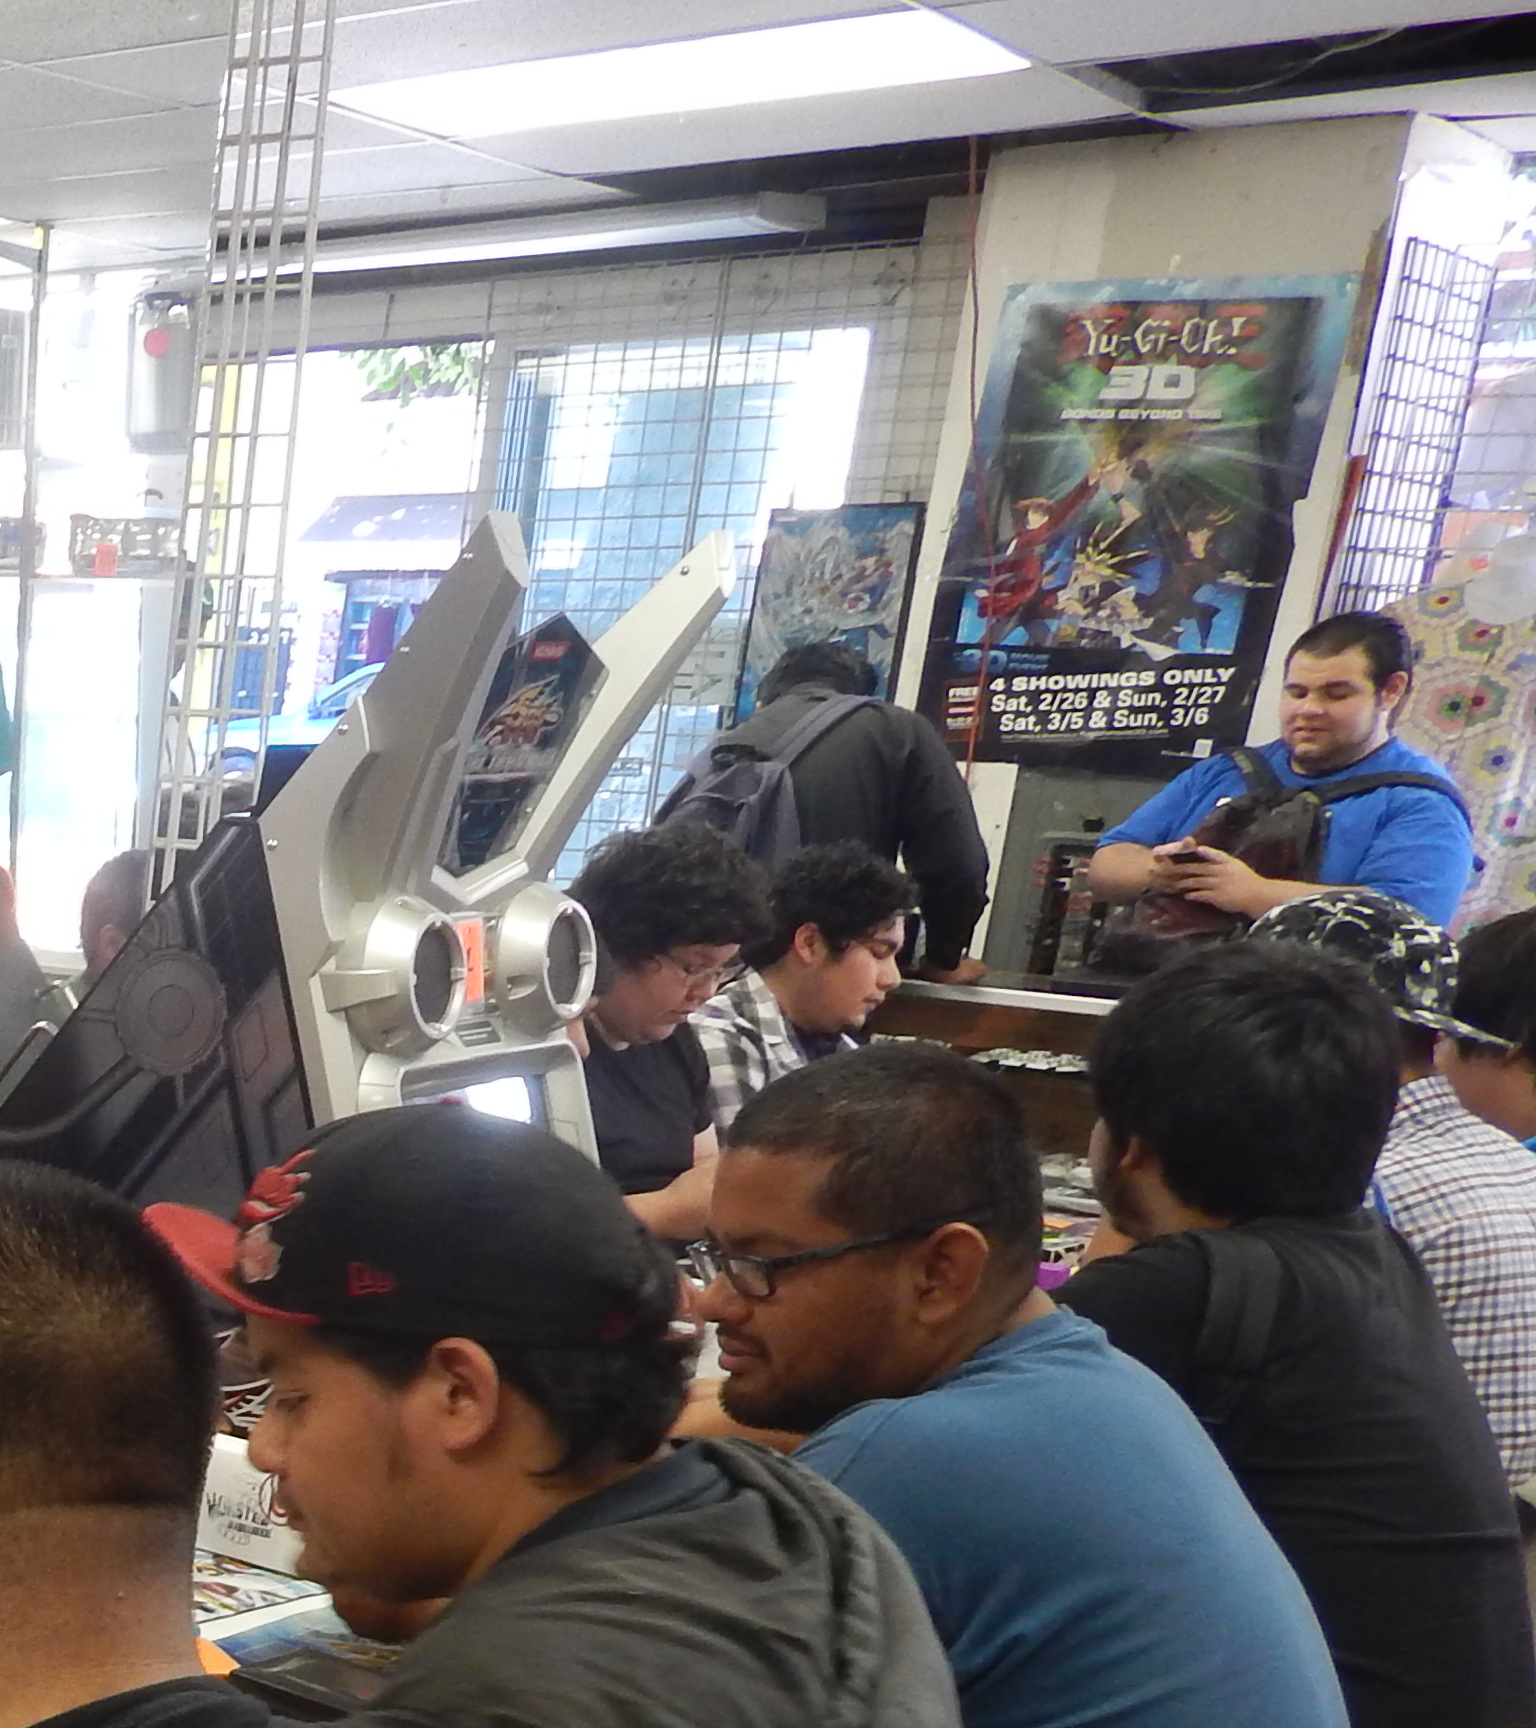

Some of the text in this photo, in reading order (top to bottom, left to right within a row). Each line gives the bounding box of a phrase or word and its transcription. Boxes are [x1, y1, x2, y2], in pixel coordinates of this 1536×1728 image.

[1099, 364, 1195, 401] 3D
[989, 667, 1236, 692] 4 SHOWINGS ONLY
[990, 686, 1226, 713] Sat, 2/26 & Sun, 2/27
[999, 713, 1042, 733] Sat,
[1047, 711, 1084, 731] 3/5
[1089, 710, 1108, 729] &
[1112, 708, 1164, 729] Sun,
[1169, 707, 1209, 727] 3/6
